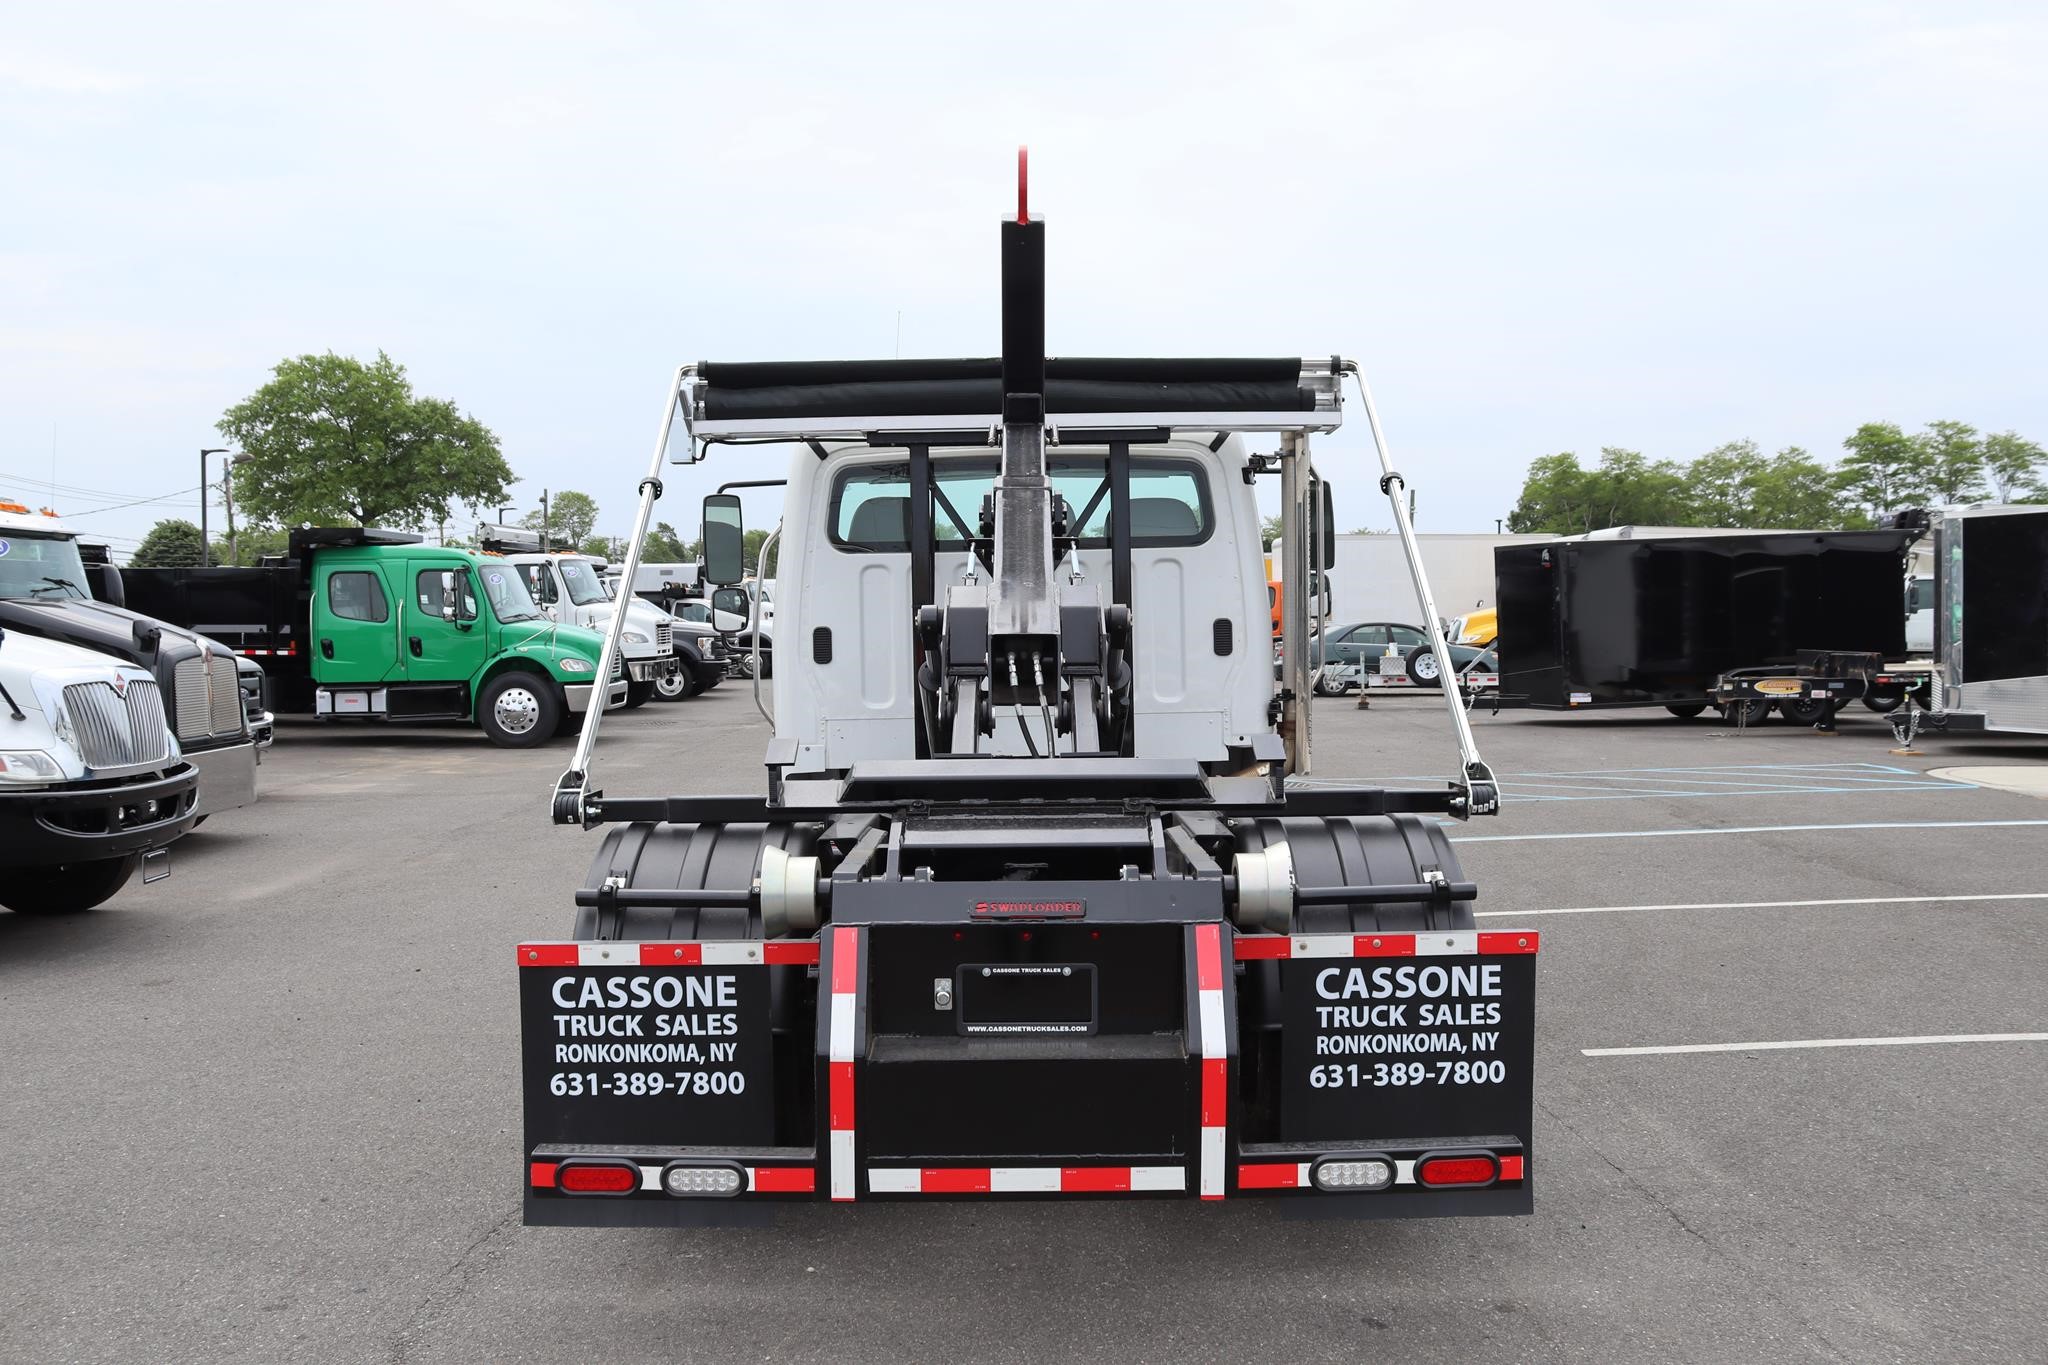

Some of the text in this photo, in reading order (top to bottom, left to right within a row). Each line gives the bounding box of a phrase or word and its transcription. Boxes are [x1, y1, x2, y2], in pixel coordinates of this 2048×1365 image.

[990, 902, 1081, 913] SWAPLOADER
[551, 975, 738, 1009] CASSONE
[1315, 965, 1502, 1000] CASSONE
[553, 1013, 738, 1037] TRUCK SALES
[1315, 1003, 1501, 1028] TRUCK SALES
[967, 1025, 1088, 1033] WWW.CASSONETRUCKSALES.COM
[555, 1042, 738, 1065] RONKONKOMA, NY
[1316, 1031, 1500, 1055] RONKONKOMA, NY
[550, 1071, 745, 1096] 631-389-7800
[1309, 1060, 1506, 1088] 631-389-7800
